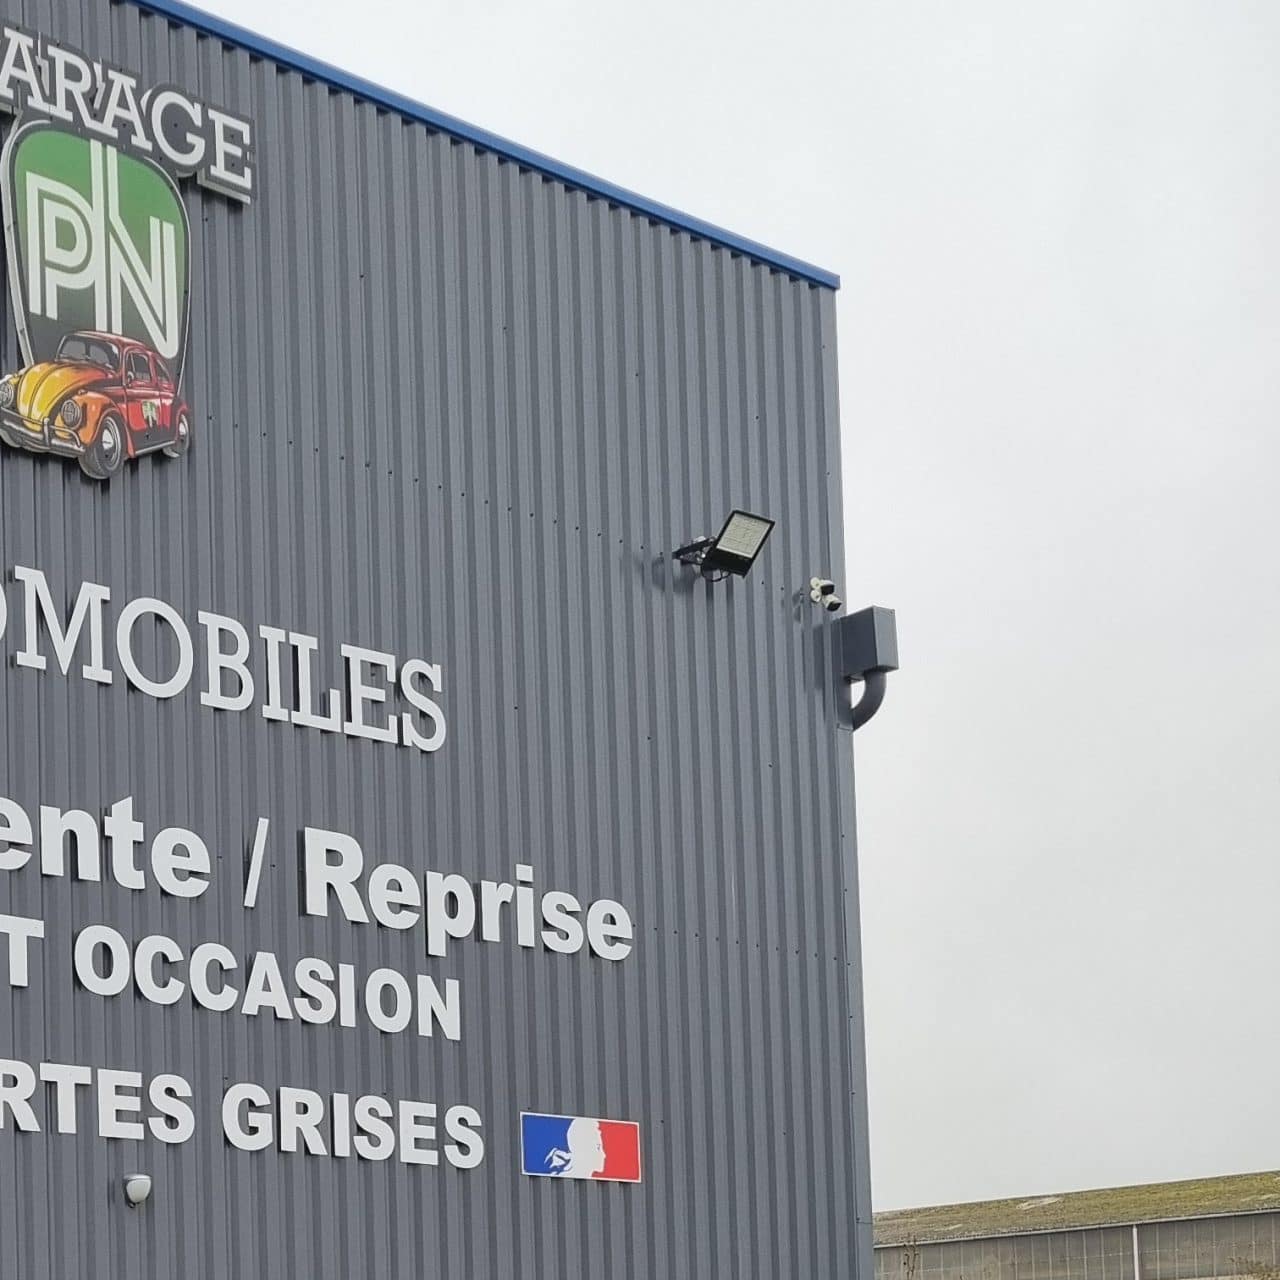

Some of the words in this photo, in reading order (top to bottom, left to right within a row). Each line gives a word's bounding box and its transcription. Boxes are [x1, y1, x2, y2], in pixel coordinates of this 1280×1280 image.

[243, 817, 269, 908] /
[304, 826, 634, 961] Reprise
[74, 924, 461, 1041] OCCASION
[223, 1082, 486, 1169] GRISES
